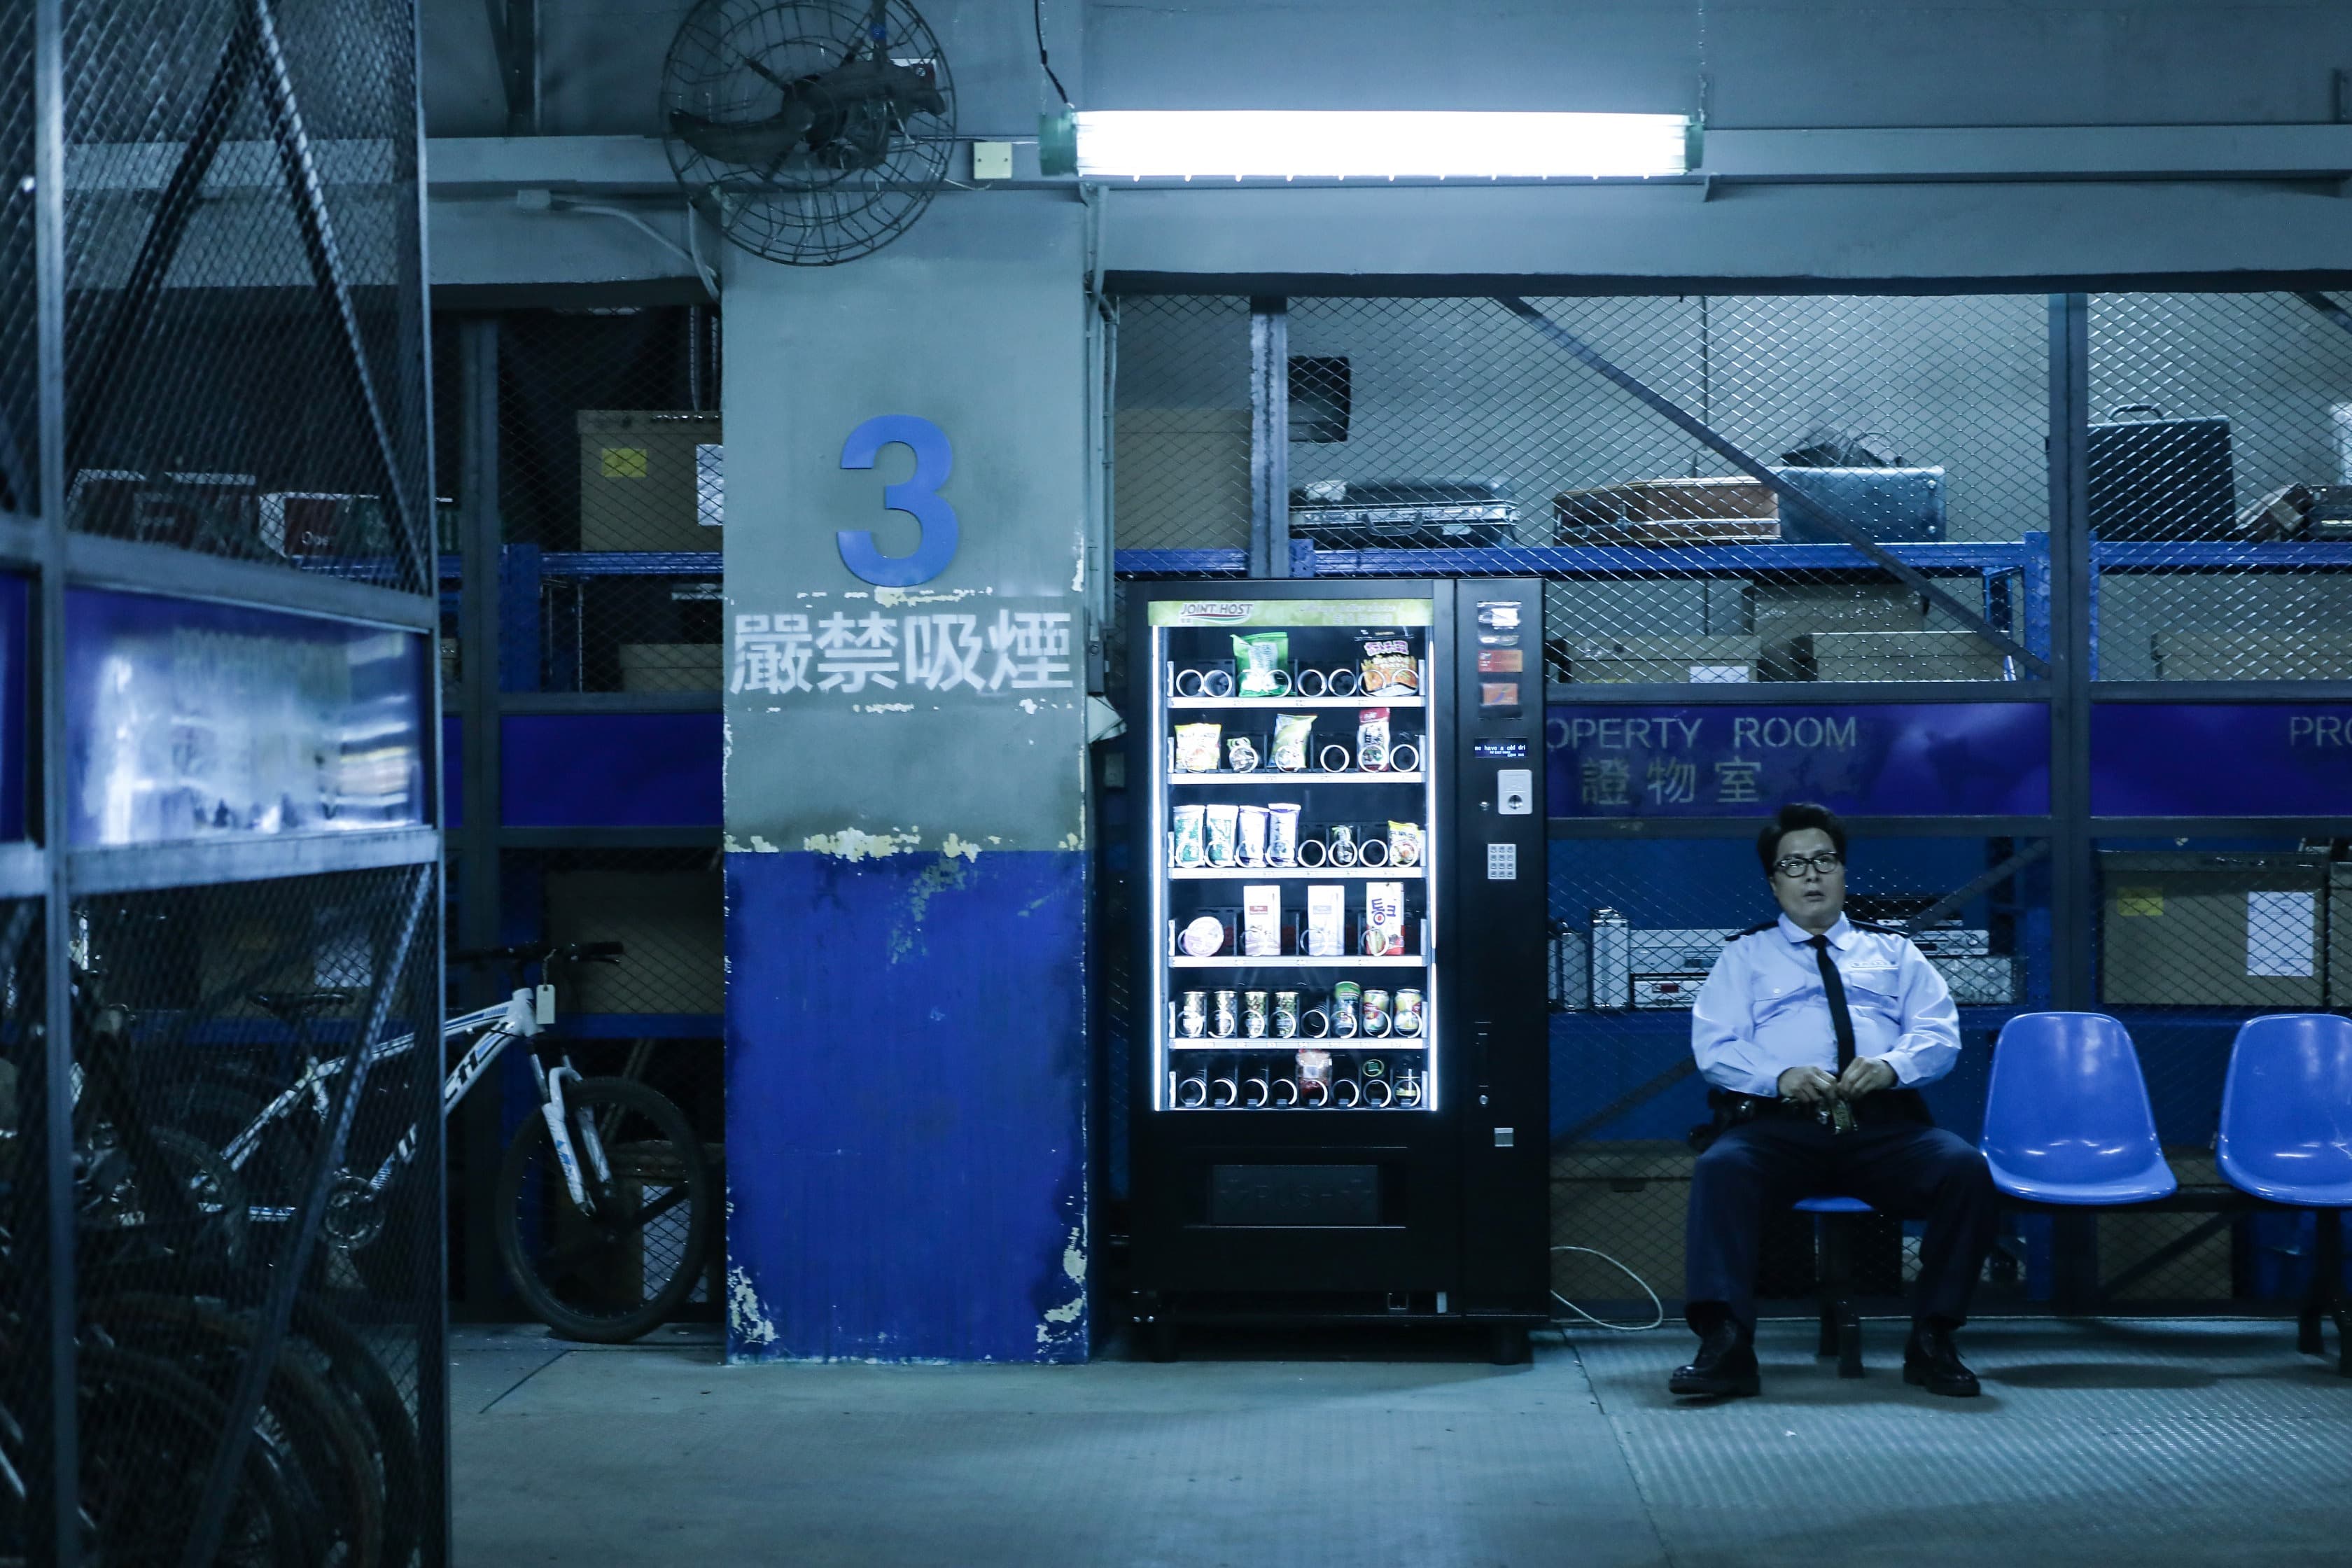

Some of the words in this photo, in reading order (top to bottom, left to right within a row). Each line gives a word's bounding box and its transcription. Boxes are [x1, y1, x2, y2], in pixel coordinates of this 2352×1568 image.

[837, 414, 958, 587] 3
[1182, 603, 1217, 615] JOINT
[1220, 603, 1254, 615] HOST
[730, 609, 1073, 694] 嚴禁吸煙
[1733, 716, 1857, 748] ROOM
[2290, 715, 2352, 747] PR
[1581, 756, 1762, 805] 證物室
